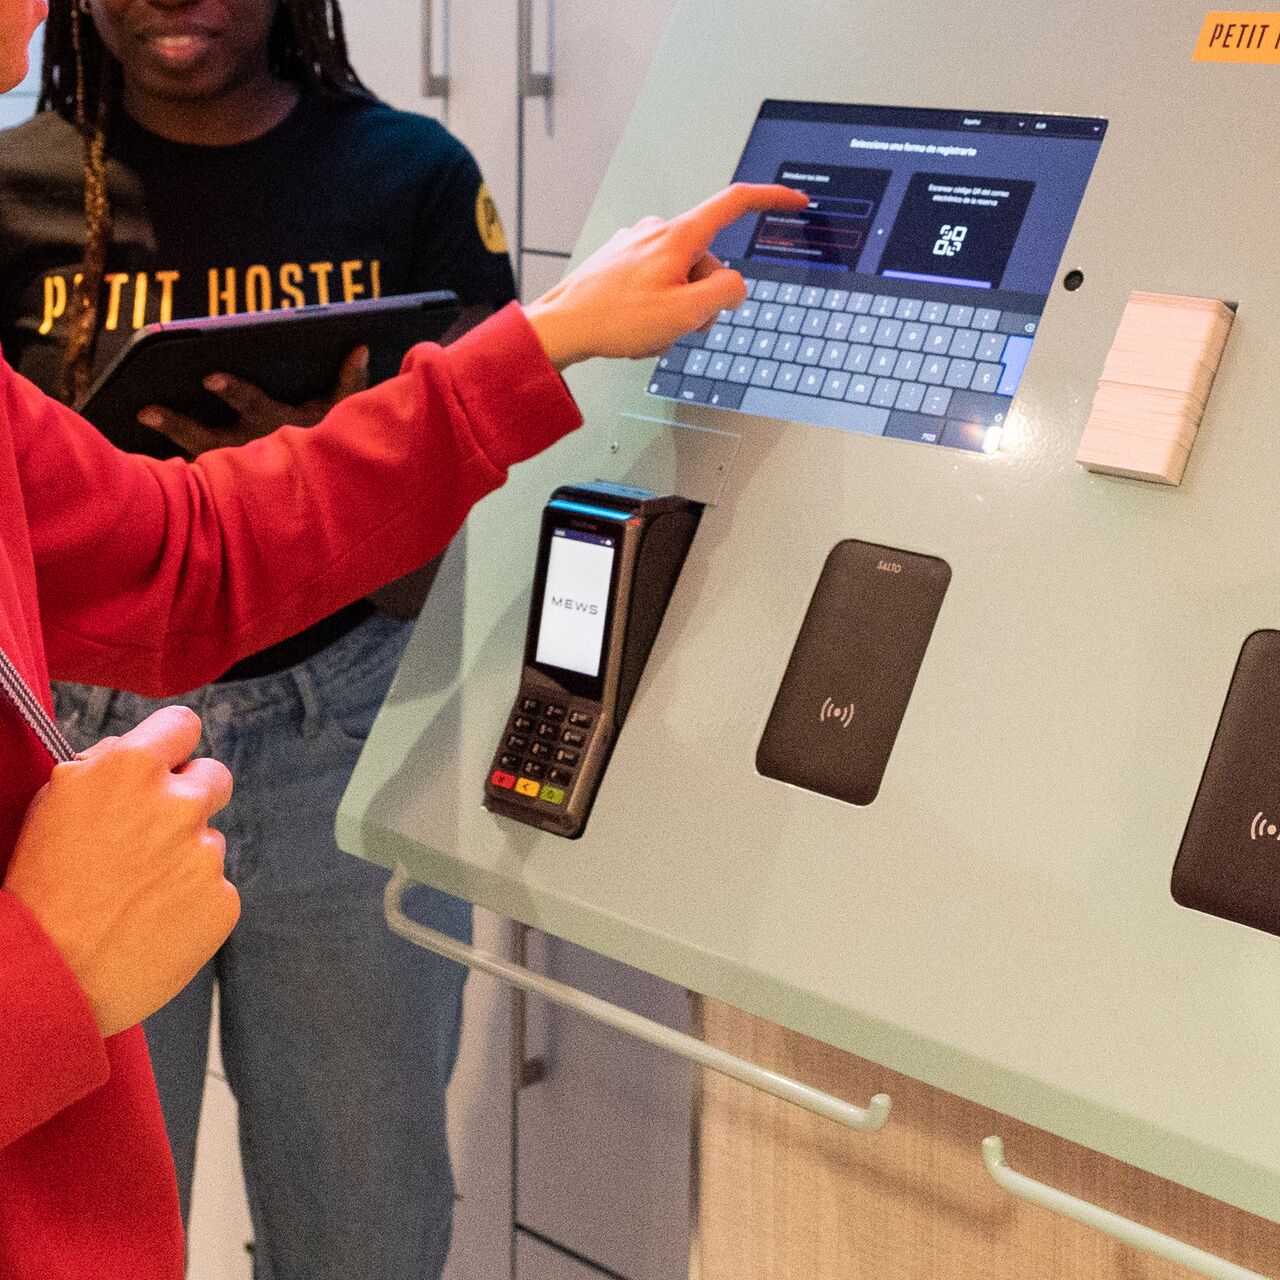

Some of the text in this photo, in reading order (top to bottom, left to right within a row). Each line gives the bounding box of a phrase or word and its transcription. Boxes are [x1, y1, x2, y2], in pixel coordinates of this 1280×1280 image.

[1208, 23, 1270, 49] PETIT
[38, 268, 181, 336] PTIT
[877, 560, 902, 574] SALTO
[551, 596, 598, 616] MEWS
